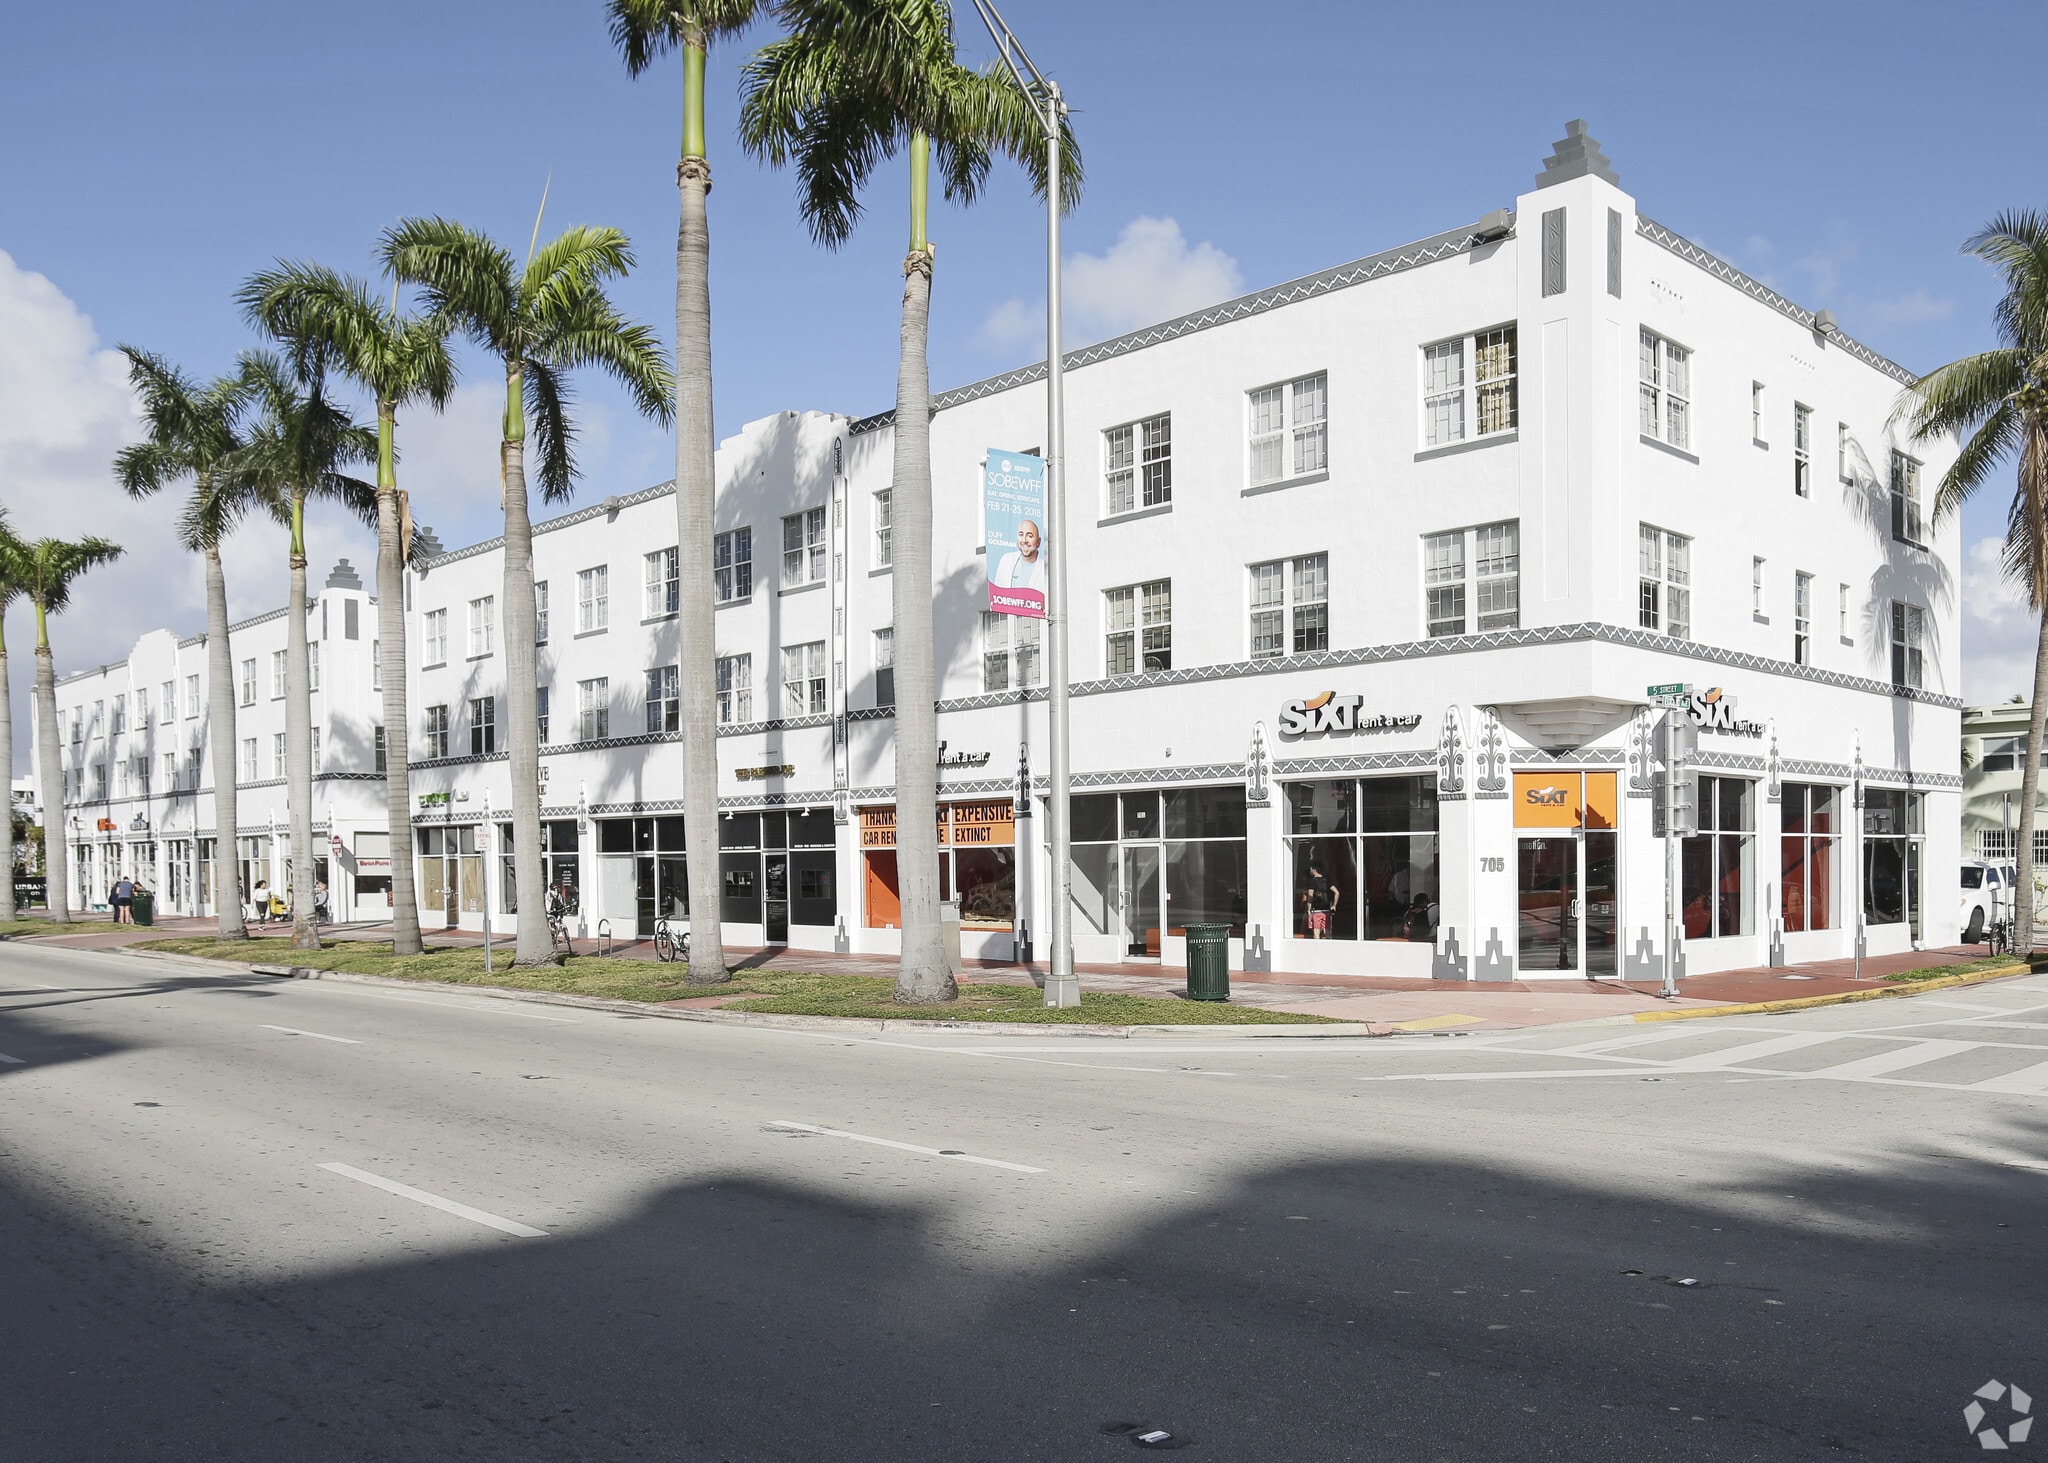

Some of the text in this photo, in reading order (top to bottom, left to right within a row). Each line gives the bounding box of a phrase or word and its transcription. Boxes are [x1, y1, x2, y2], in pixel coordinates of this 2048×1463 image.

[987, 471, 1042, 493] SOBEWFF
[987, 500, 1000, 511] FEB
[1025, 506, 1042, 518] 2018
[987, 530, 1004, 539] DUFF
[988, 538, 1018, 548] GOLDMAN
[992, 594, 1042, 610] SOBEWFF.ORG
[1357, 714, 1383, 730] rent
[1385, 716, 1394, 727] a
[1397, 714, 1419, 727] car
[1735, 720, 1750, 732] rent
[941, 752, 961, 764] rent
[864, 809, 897, 826] THANK
[955, 802, 1013, 823] EXPENSIVE
[863, 831, 879, 845] CAR
[955, 827, 991, 843] EXTINCT
[1480, 857, 1505, 872] 705
